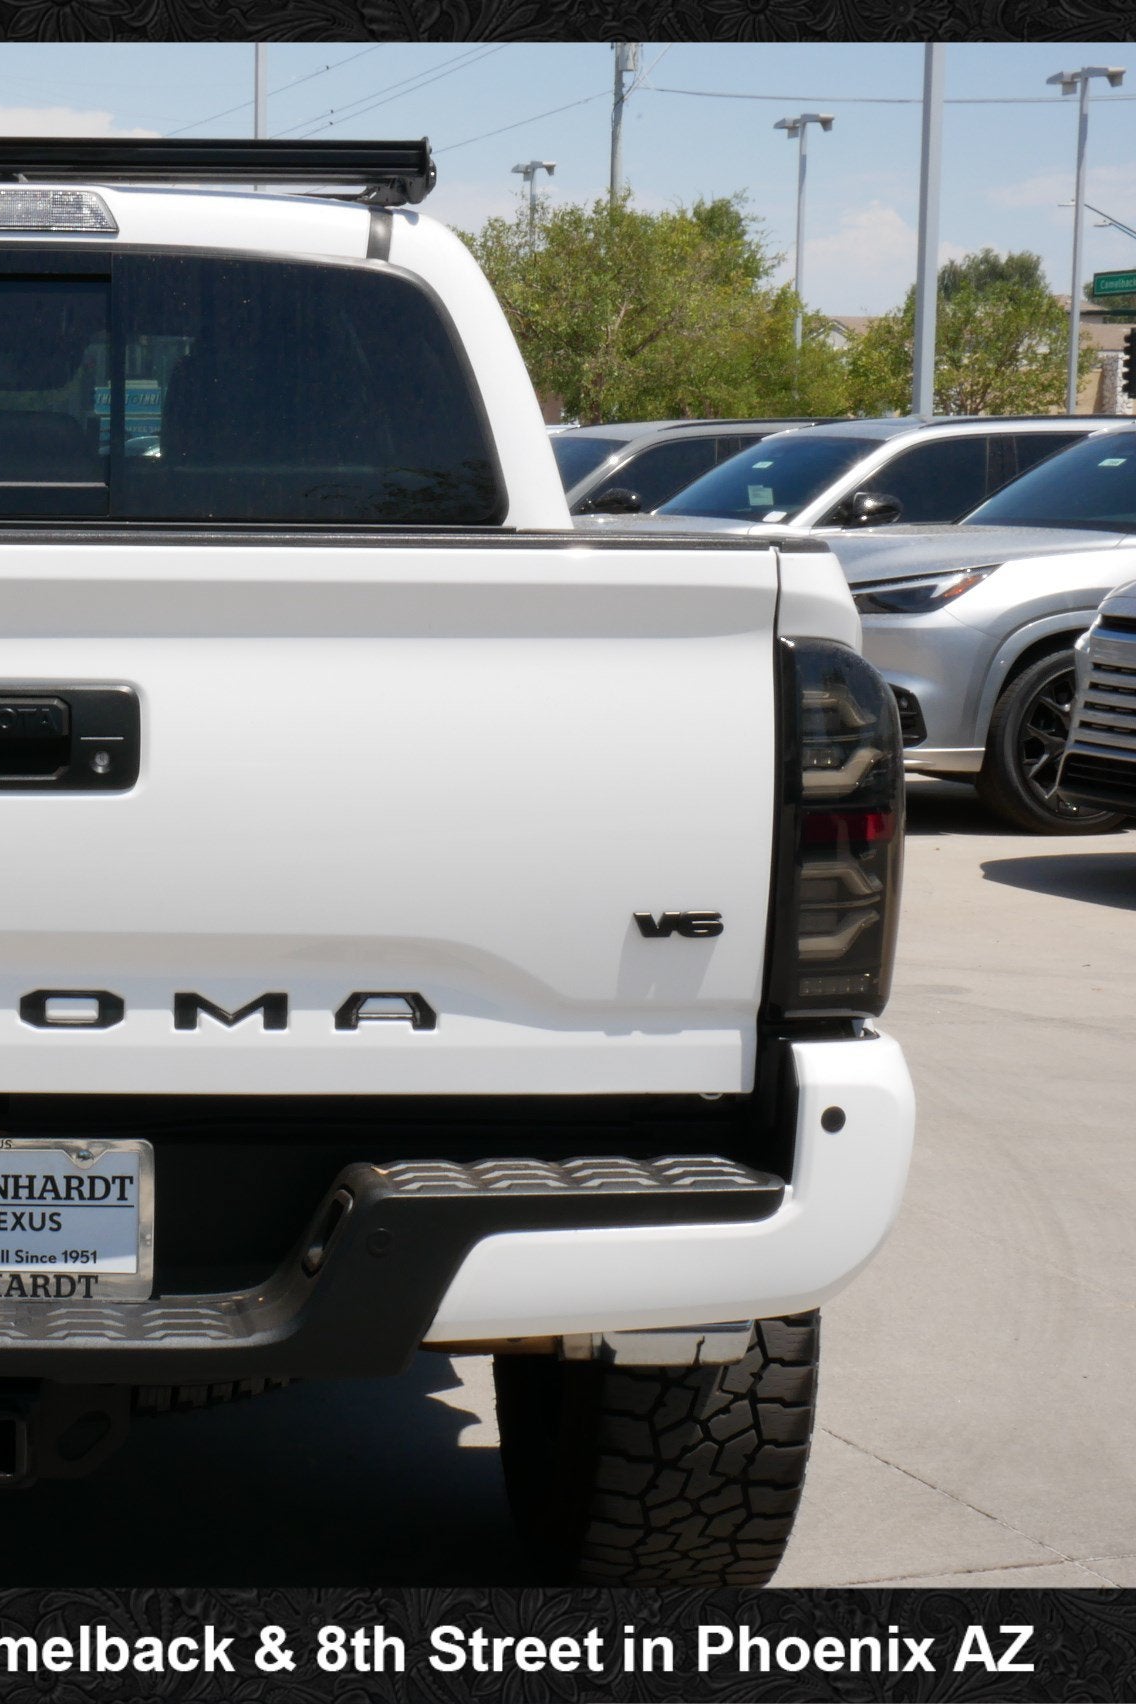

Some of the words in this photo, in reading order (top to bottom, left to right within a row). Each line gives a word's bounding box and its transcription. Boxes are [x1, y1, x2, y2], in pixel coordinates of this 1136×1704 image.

[633, 911, 724, 938] V6
[14, 1249, 57, 1265] Since
[62, 1249, 98, 1265] 1951
